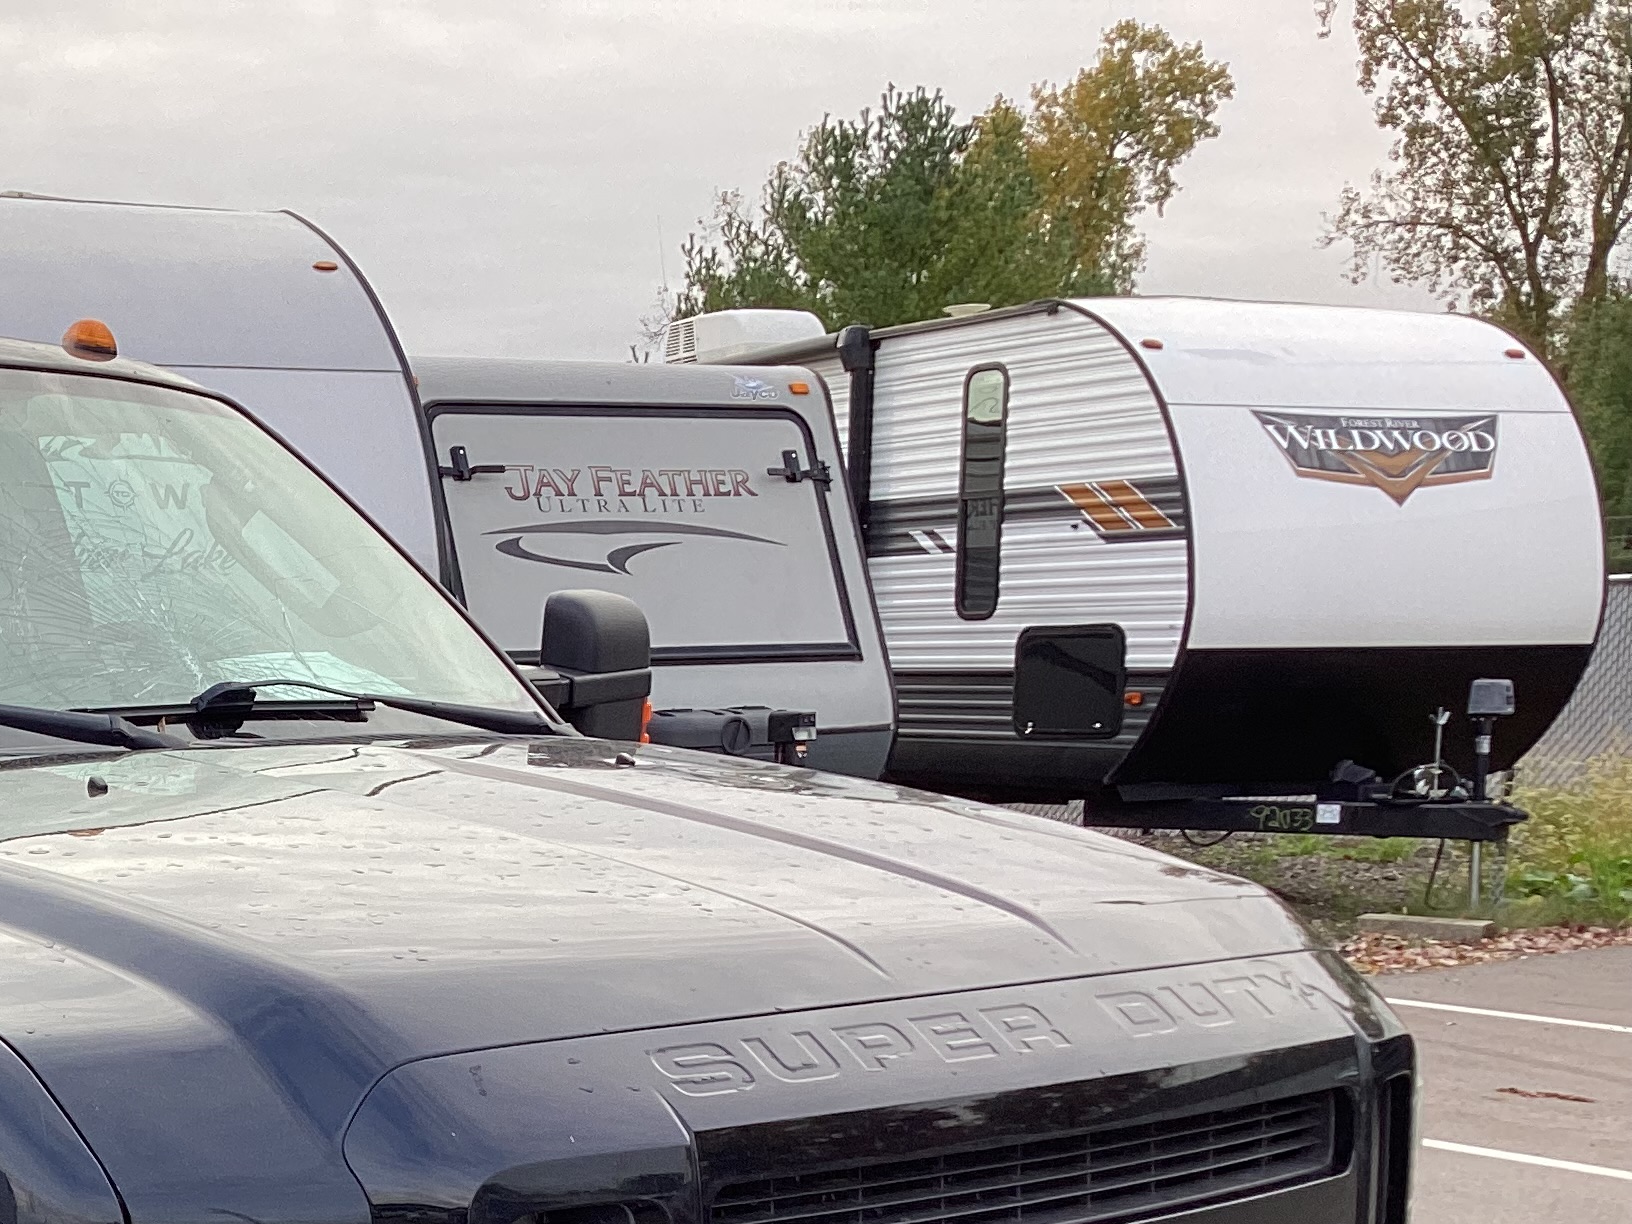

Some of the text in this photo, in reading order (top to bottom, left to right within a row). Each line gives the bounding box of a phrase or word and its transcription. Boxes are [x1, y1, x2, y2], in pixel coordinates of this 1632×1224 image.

[1340, 417, 1420, 429] FOREST RIVER
[1264, 424, 1496, 452] WILDWOOD
[503, 464, 760, 501] JAY FEATHER
[536, 497, 707, 513] ULTRA LITE
[645, 970, 1332, 1098] SUPER DUTY
